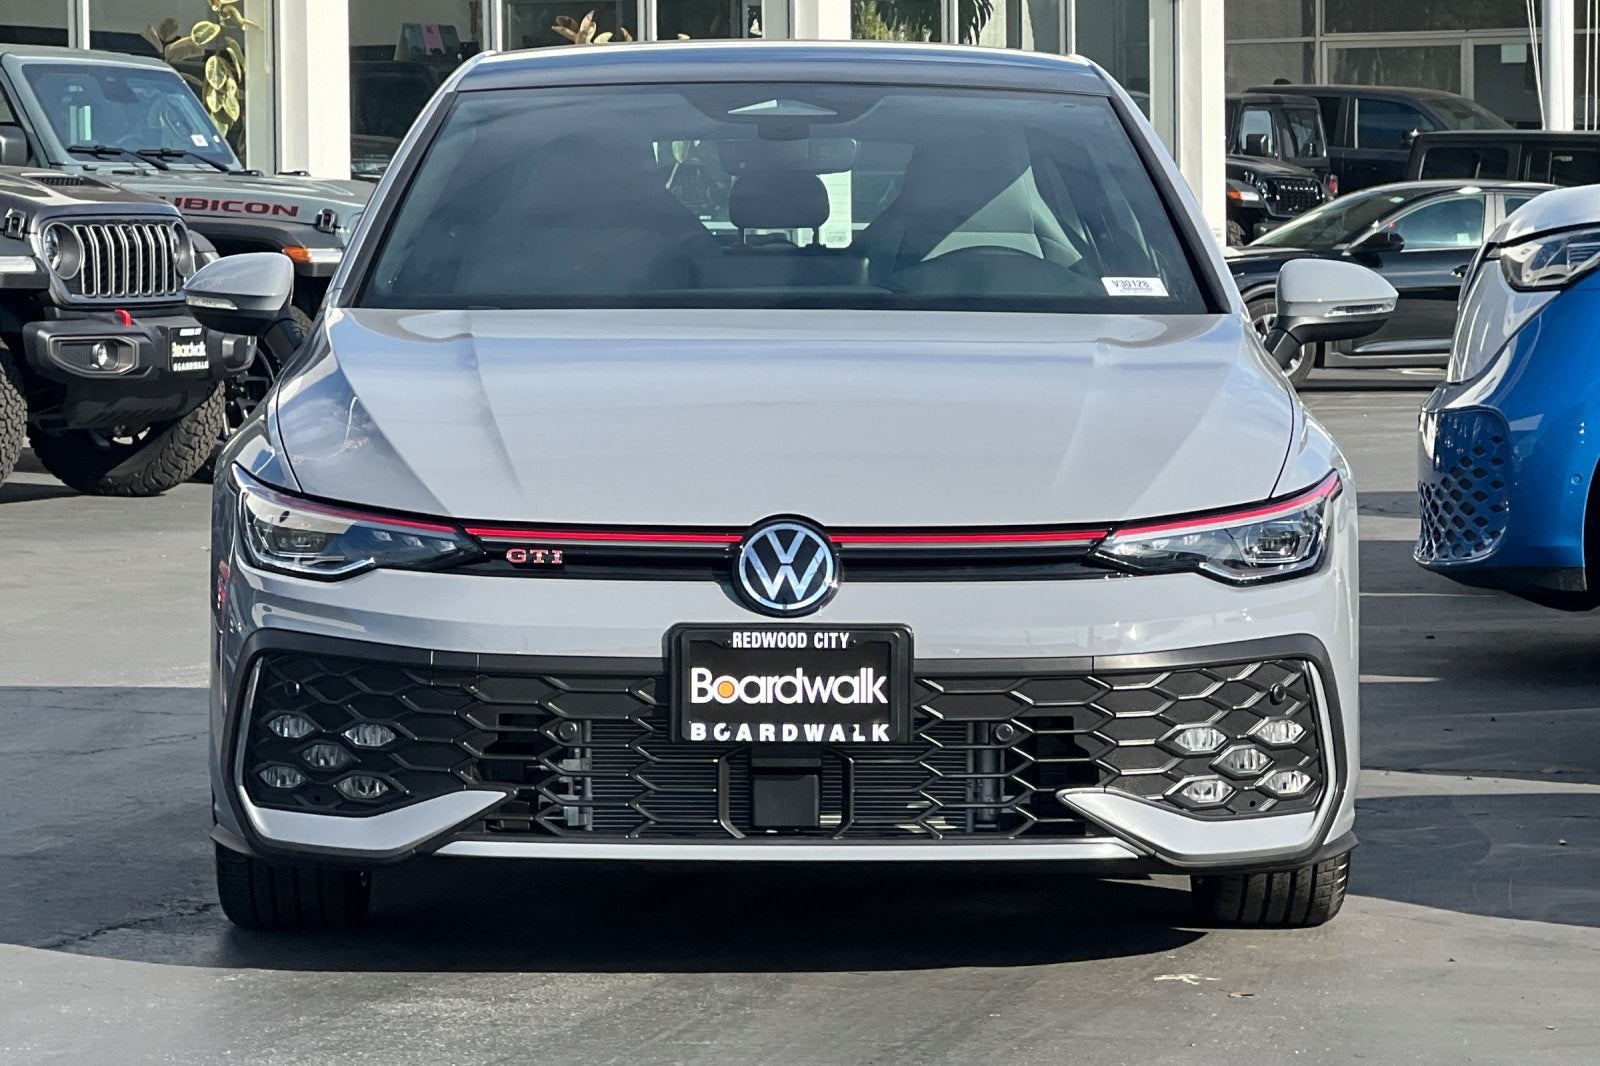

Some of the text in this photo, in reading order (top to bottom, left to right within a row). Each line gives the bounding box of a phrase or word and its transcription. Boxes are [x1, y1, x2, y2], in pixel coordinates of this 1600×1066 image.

[158, 195, 299, 217] BICON
[505, 548, 563, 564] GTI
[732, 631, 850, 649] REDWOOD CITY
[690, 667, 889, 705] Boardwalk
[690, 722, 890, 742] BOARDWALK
